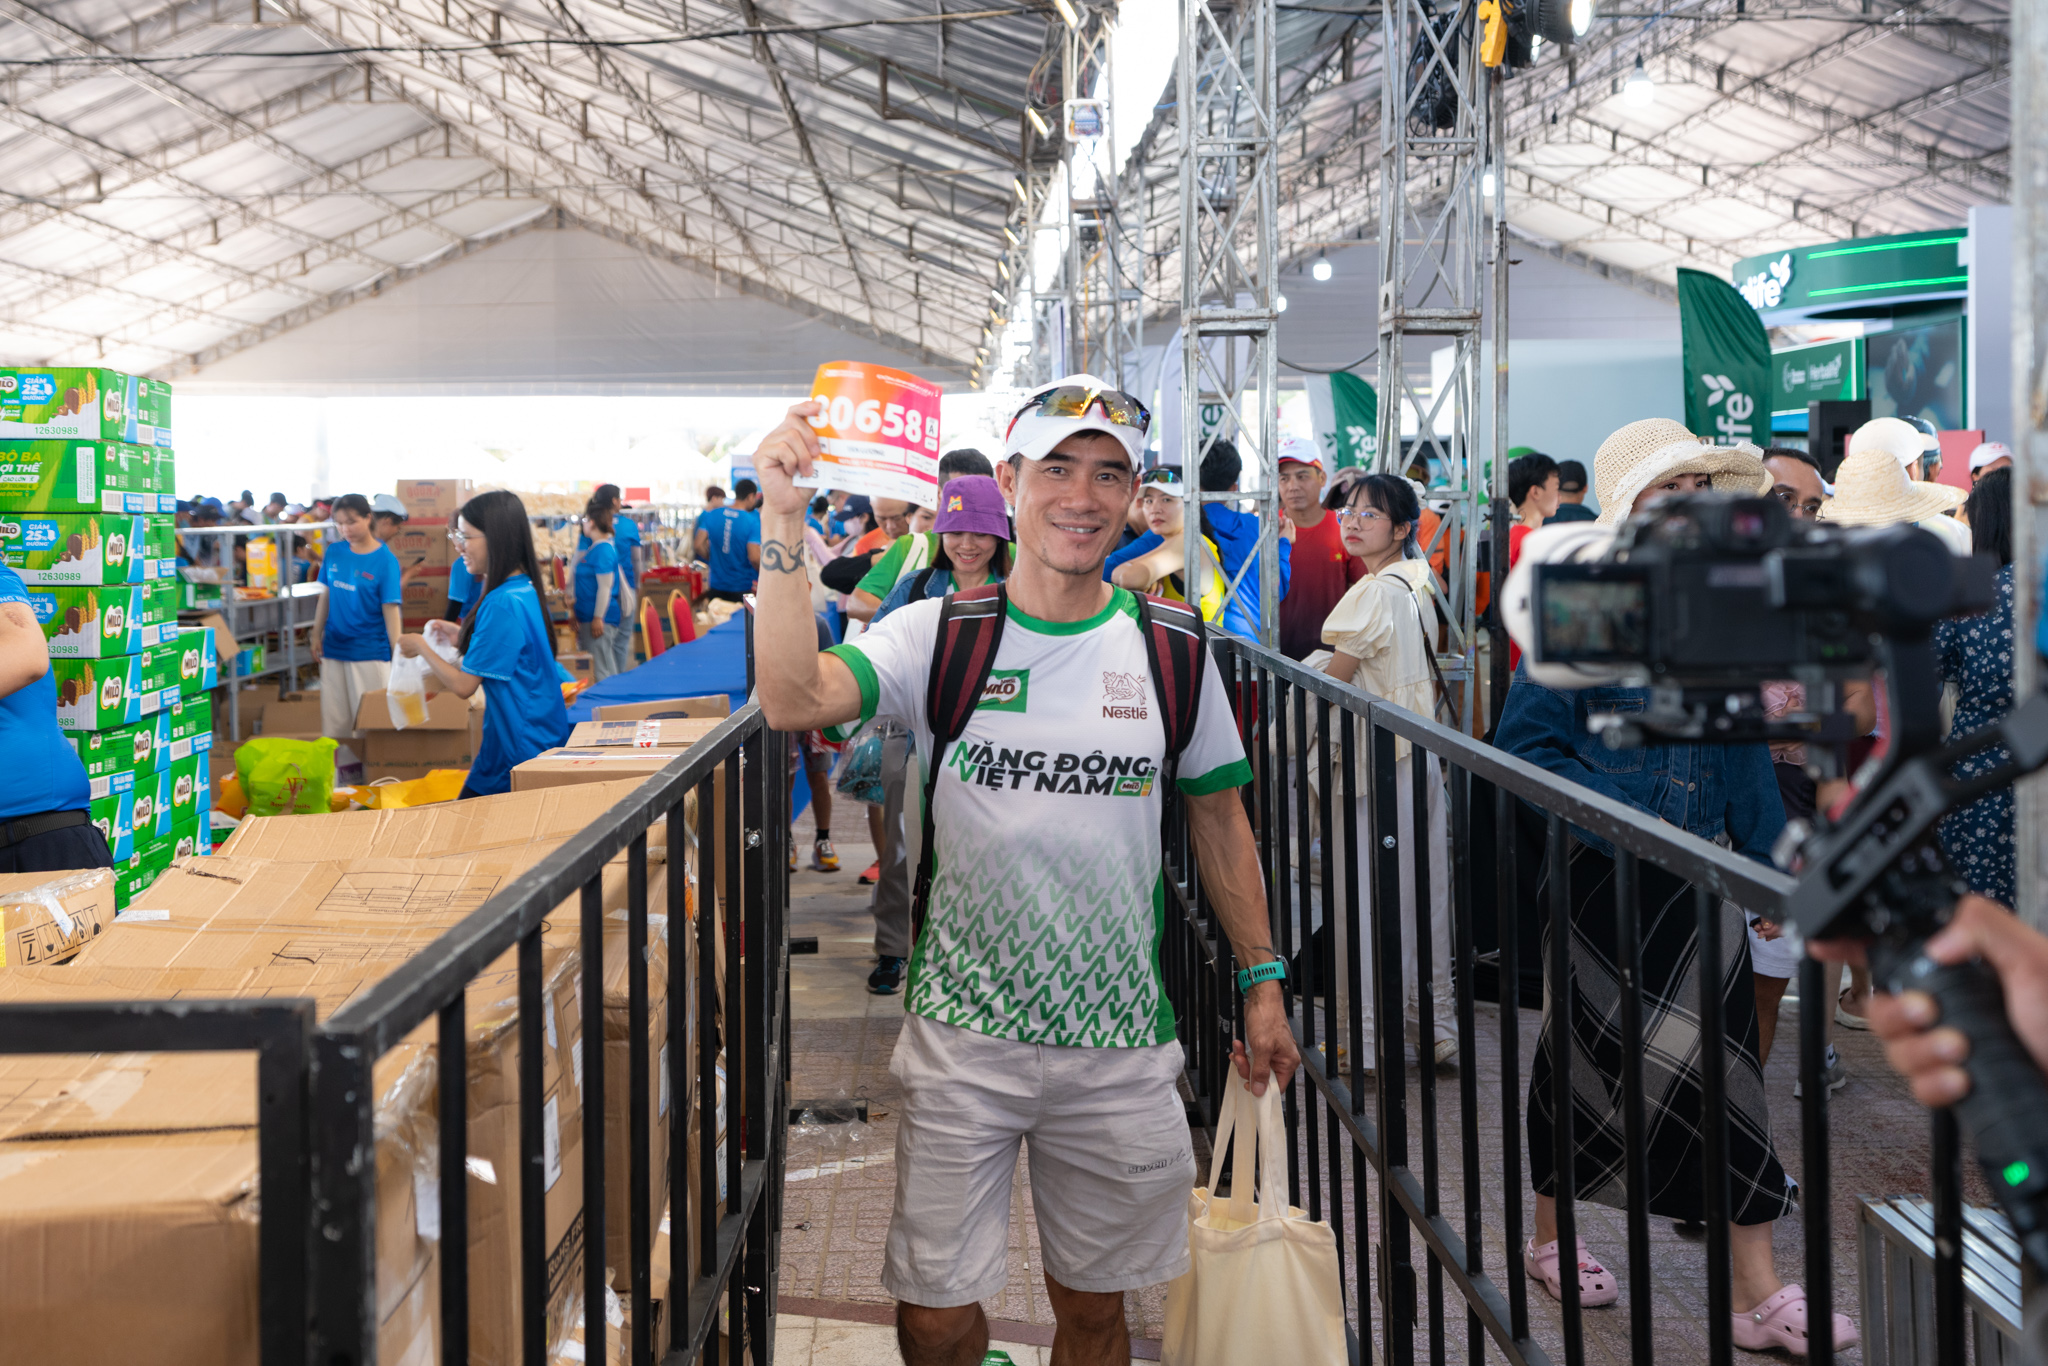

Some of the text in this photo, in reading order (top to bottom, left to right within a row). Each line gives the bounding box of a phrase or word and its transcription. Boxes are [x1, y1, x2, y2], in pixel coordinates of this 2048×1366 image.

[807, 394, 922, 443] 30658
[35, 426, 78, 435] 12630989
[21, 452, 41, 462] BA
[16, 462, 43, 473] THẾ
[1103, 706, 1148, 719] Nestlé
[948, 741, 1048, 771] NĂNG
[959, 760, 1115, 796] VIỆT NAM
